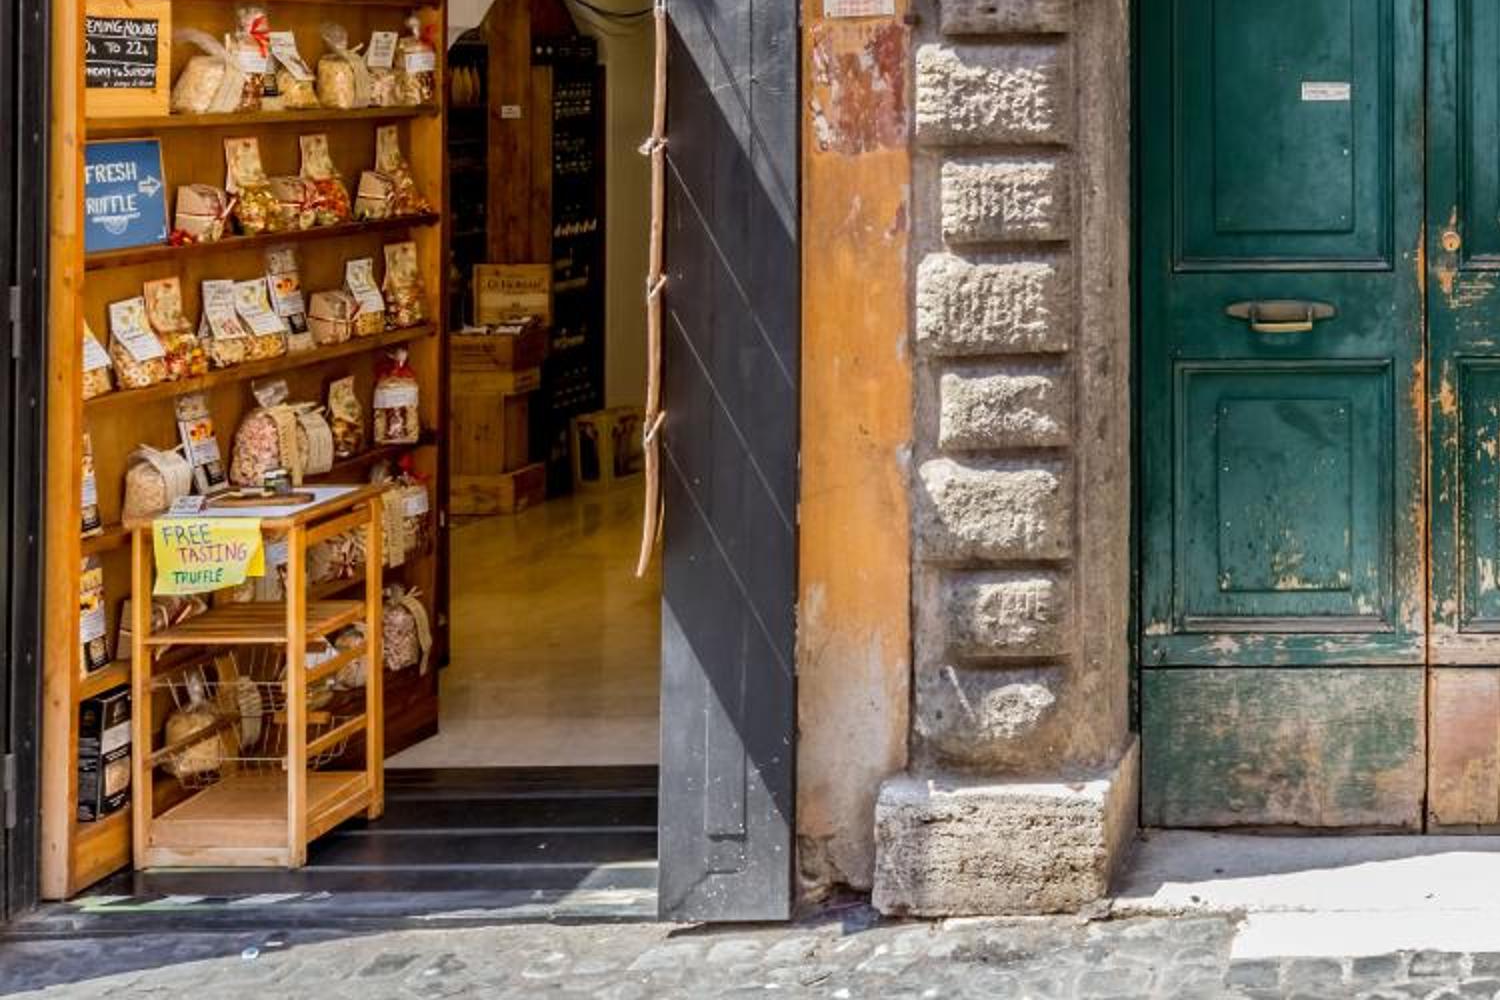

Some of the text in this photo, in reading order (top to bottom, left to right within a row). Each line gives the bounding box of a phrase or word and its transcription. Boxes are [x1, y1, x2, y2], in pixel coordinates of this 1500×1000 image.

[86, 18, 123, 34] ENING
[85, 161, 137, 185] FRESH
[86, 193, 139, 215] RUFFLE
[161, 523, 210, 547] FREE
[177, 543, 248, 563] TASTING
[172, 567, 224, 584] TRUFFLE
